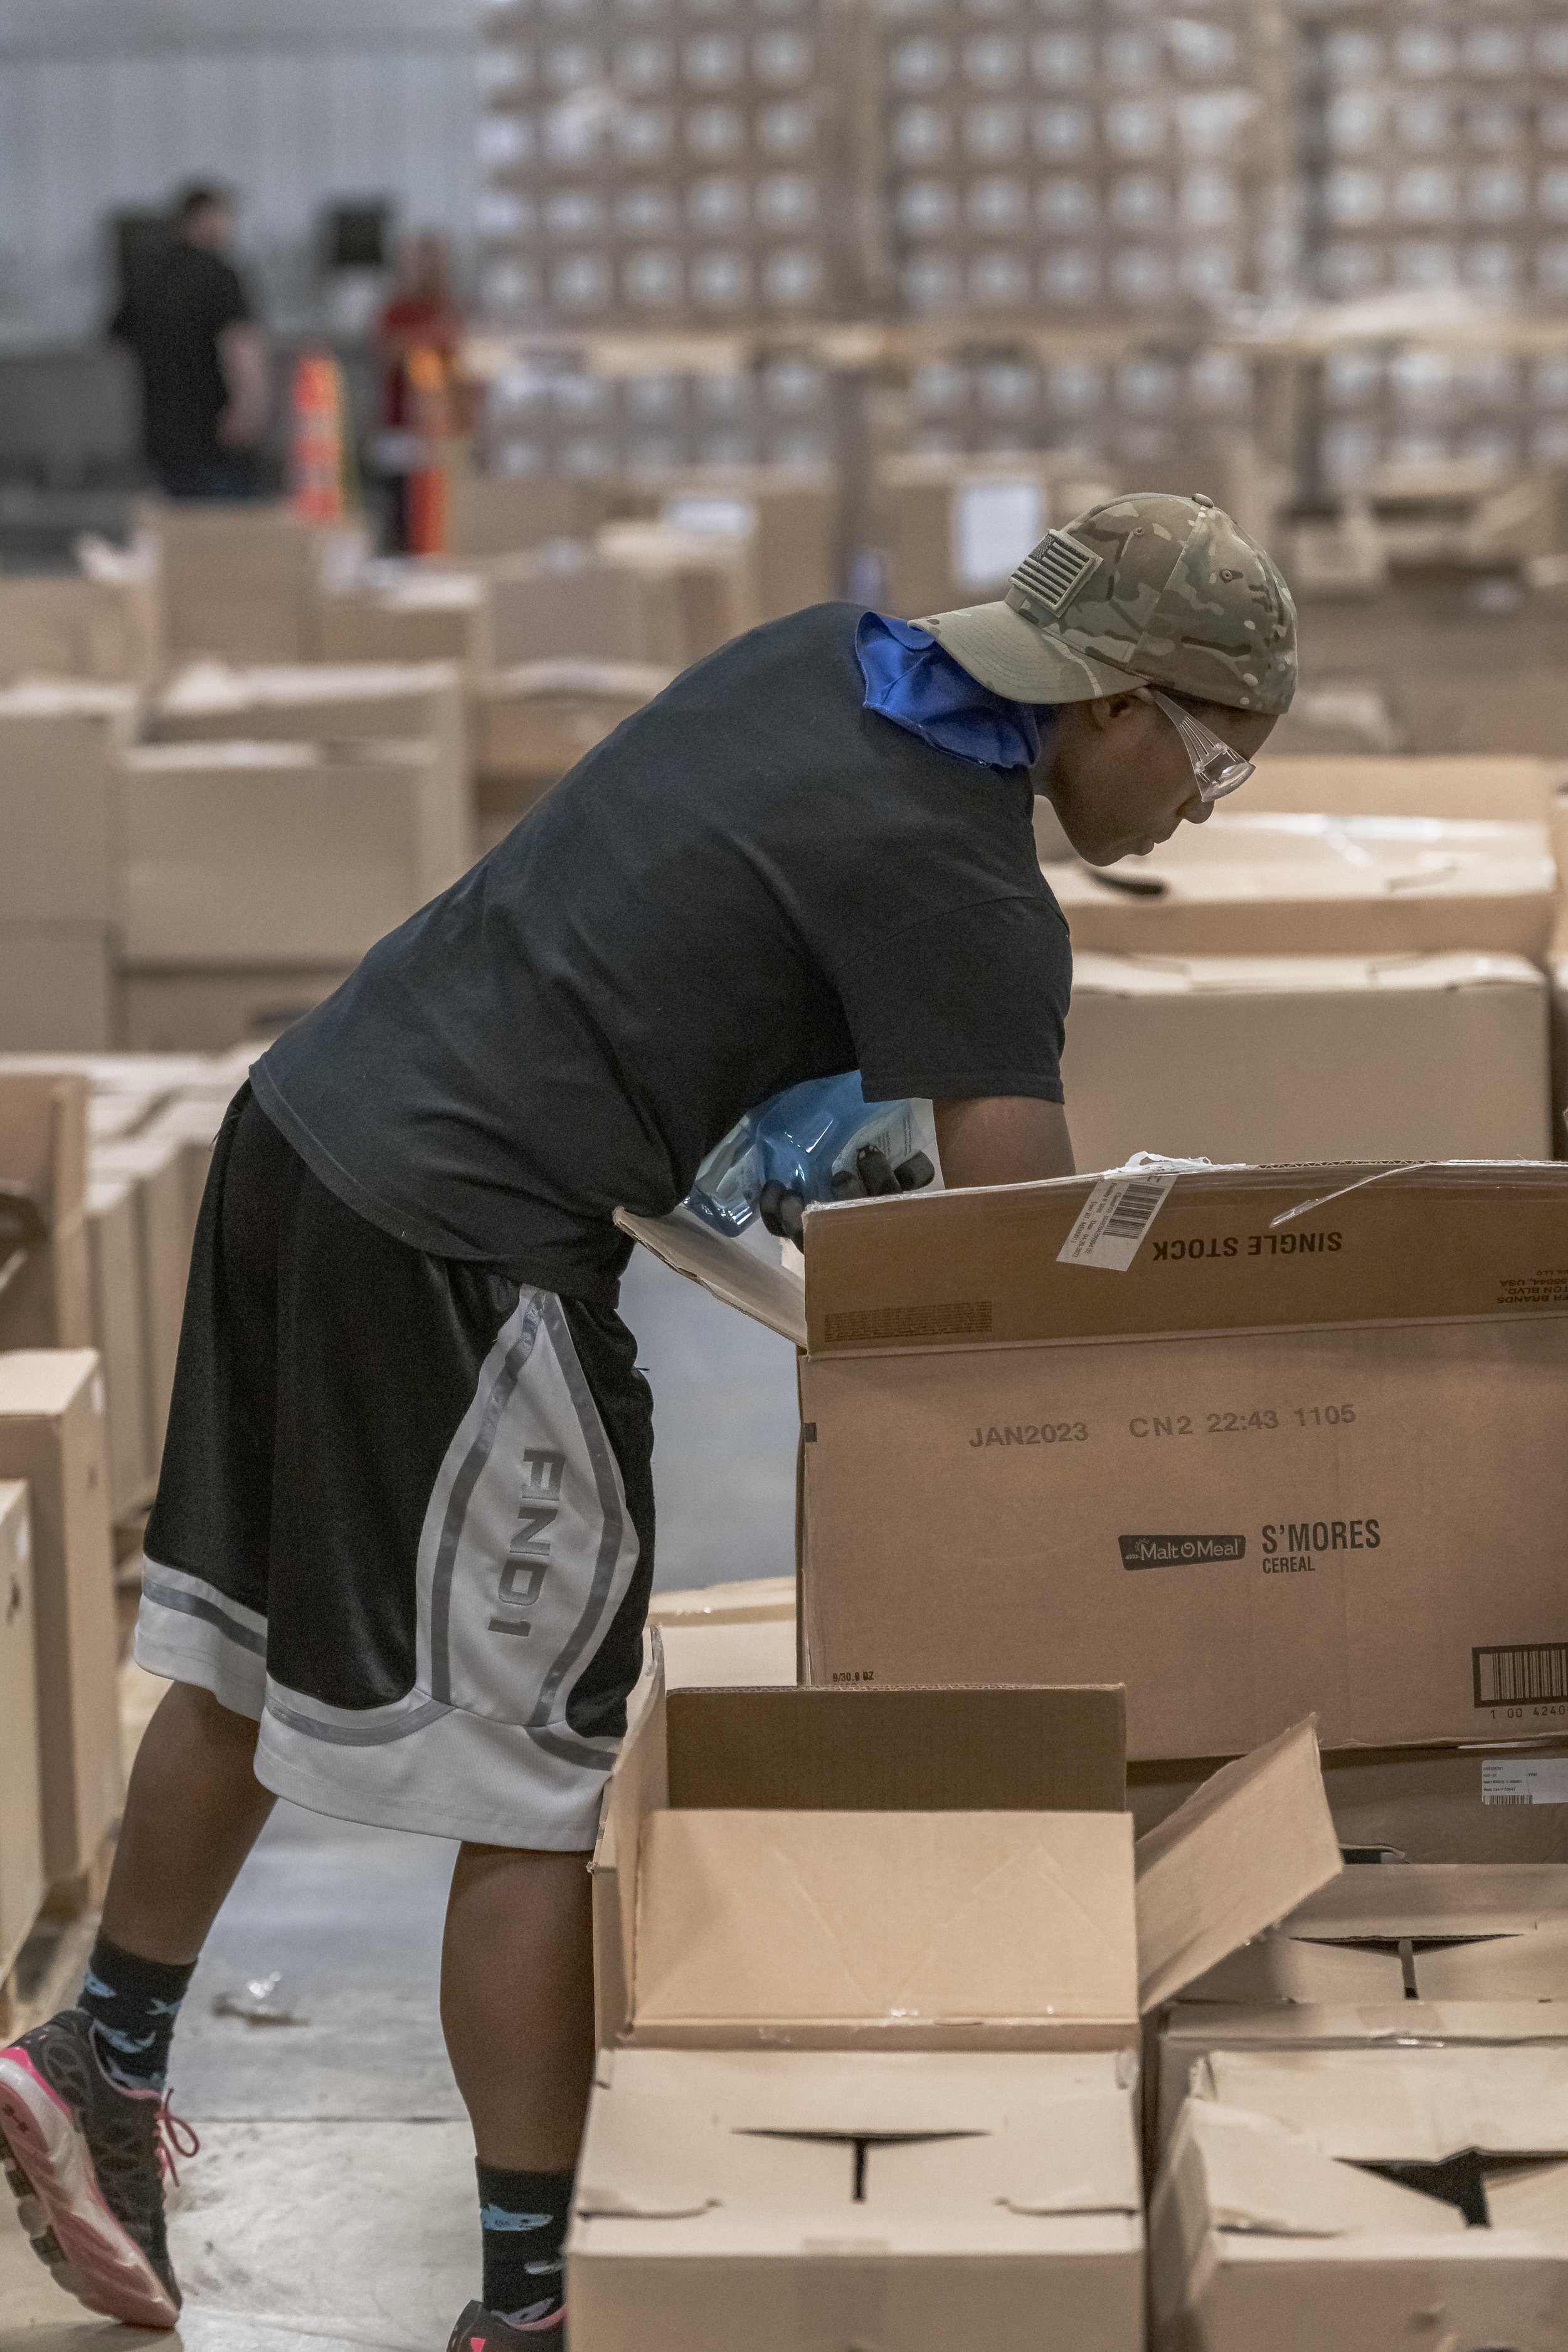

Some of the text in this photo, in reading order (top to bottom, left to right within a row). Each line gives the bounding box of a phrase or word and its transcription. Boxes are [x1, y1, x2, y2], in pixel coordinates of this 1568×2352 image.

[1152, 1231, 1342, 1261] SINGLE STOCK
[1496, 1296, 1549, 1304] BRANDS
[968, 1404, 1357, 1448] JAN2023 CN2 22:43 1105
[1262, 1518, 1380, 1554] S'MORES
[1262, 1555, 1316, 1575] CEREAL
[1490, 1709, 1495, 1719] 1
[1507, 1708, 1523, 1719] 00
